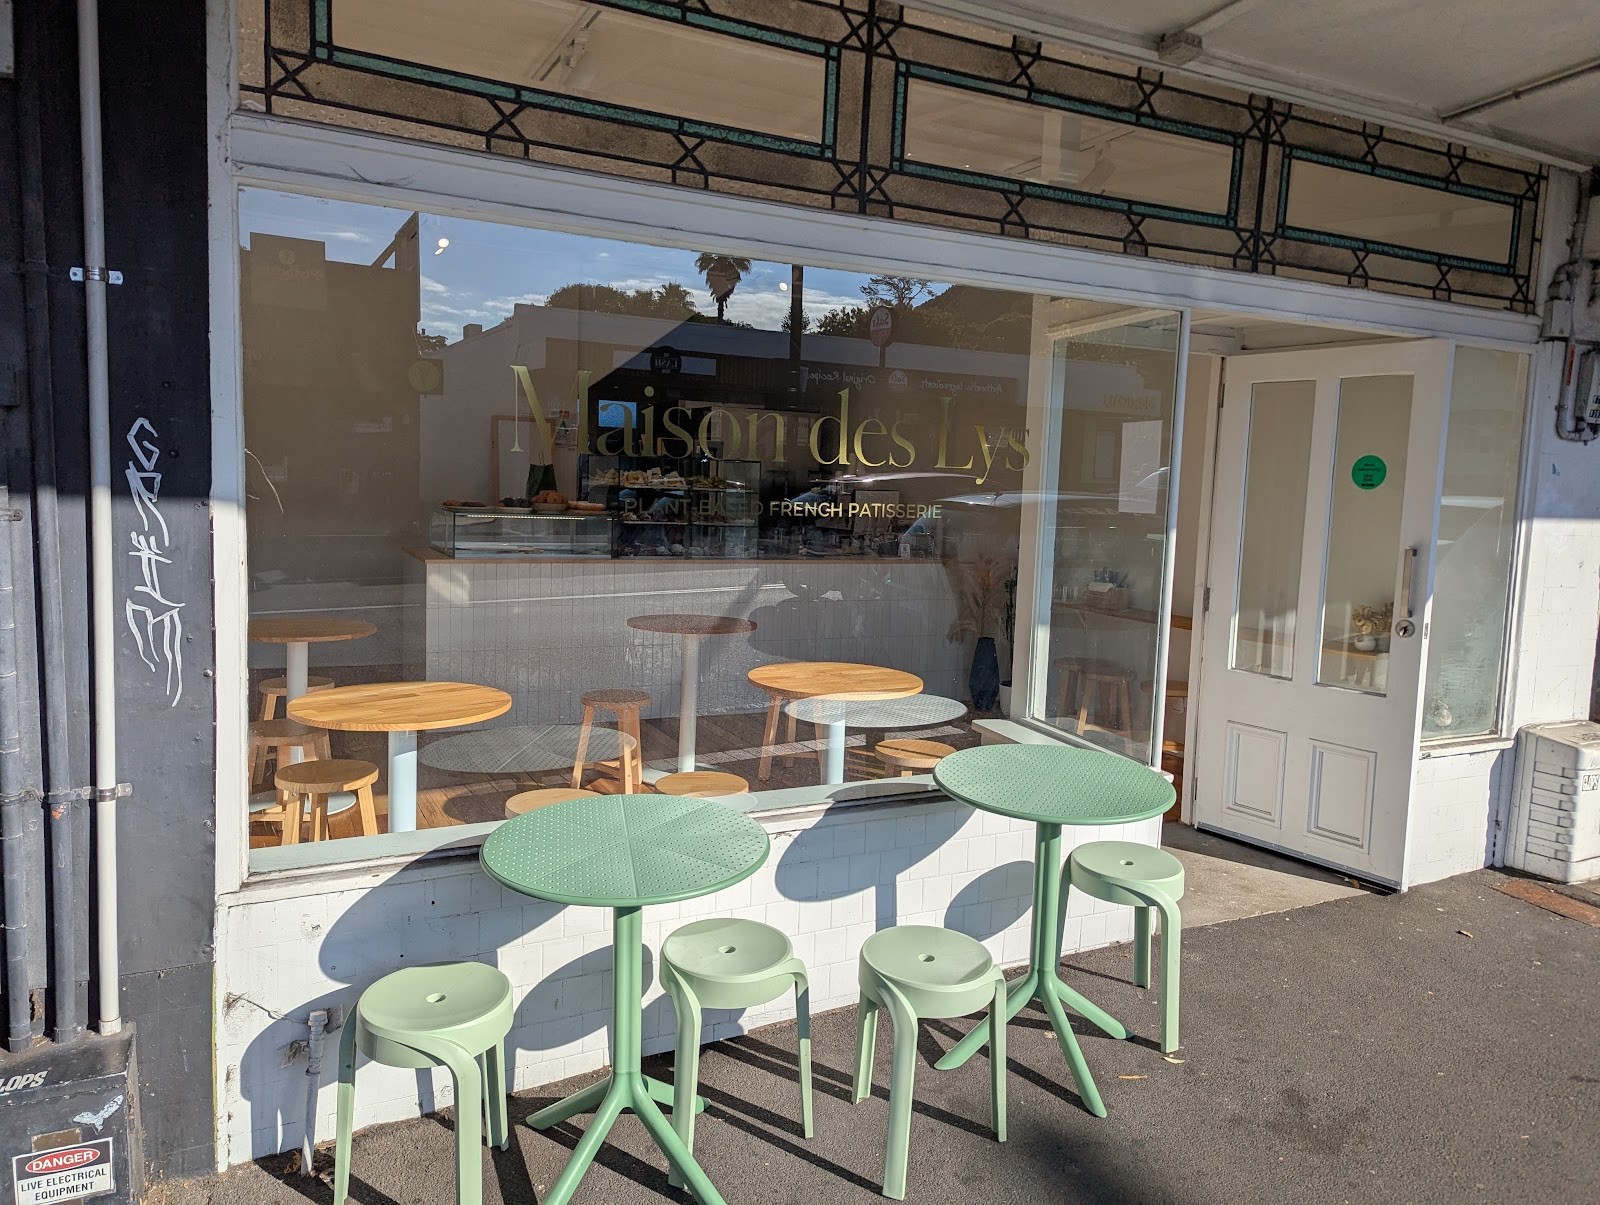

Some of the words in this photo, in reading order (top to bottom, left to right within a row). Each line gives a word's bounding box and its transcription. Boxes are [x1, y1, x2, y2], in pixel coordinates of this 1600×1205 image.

[509, 365, 787, 462] Maison
[809, 388, 916, 469] des
[934, 397, 1030, 486] Lys
[624, 497, 764, 516] PLANT-BASED
[769, 501, 843, 518] FRENCH
[848, 503, 942, 519] PATISSERIE
[32, 1151, 95, 1171] DANGER
[20, 1179, 43, 1192] LIVE
[46, 1167, 107, 1187] ELECTRICAL
[35, 1181, 95, 1201] EQUIPMENT
